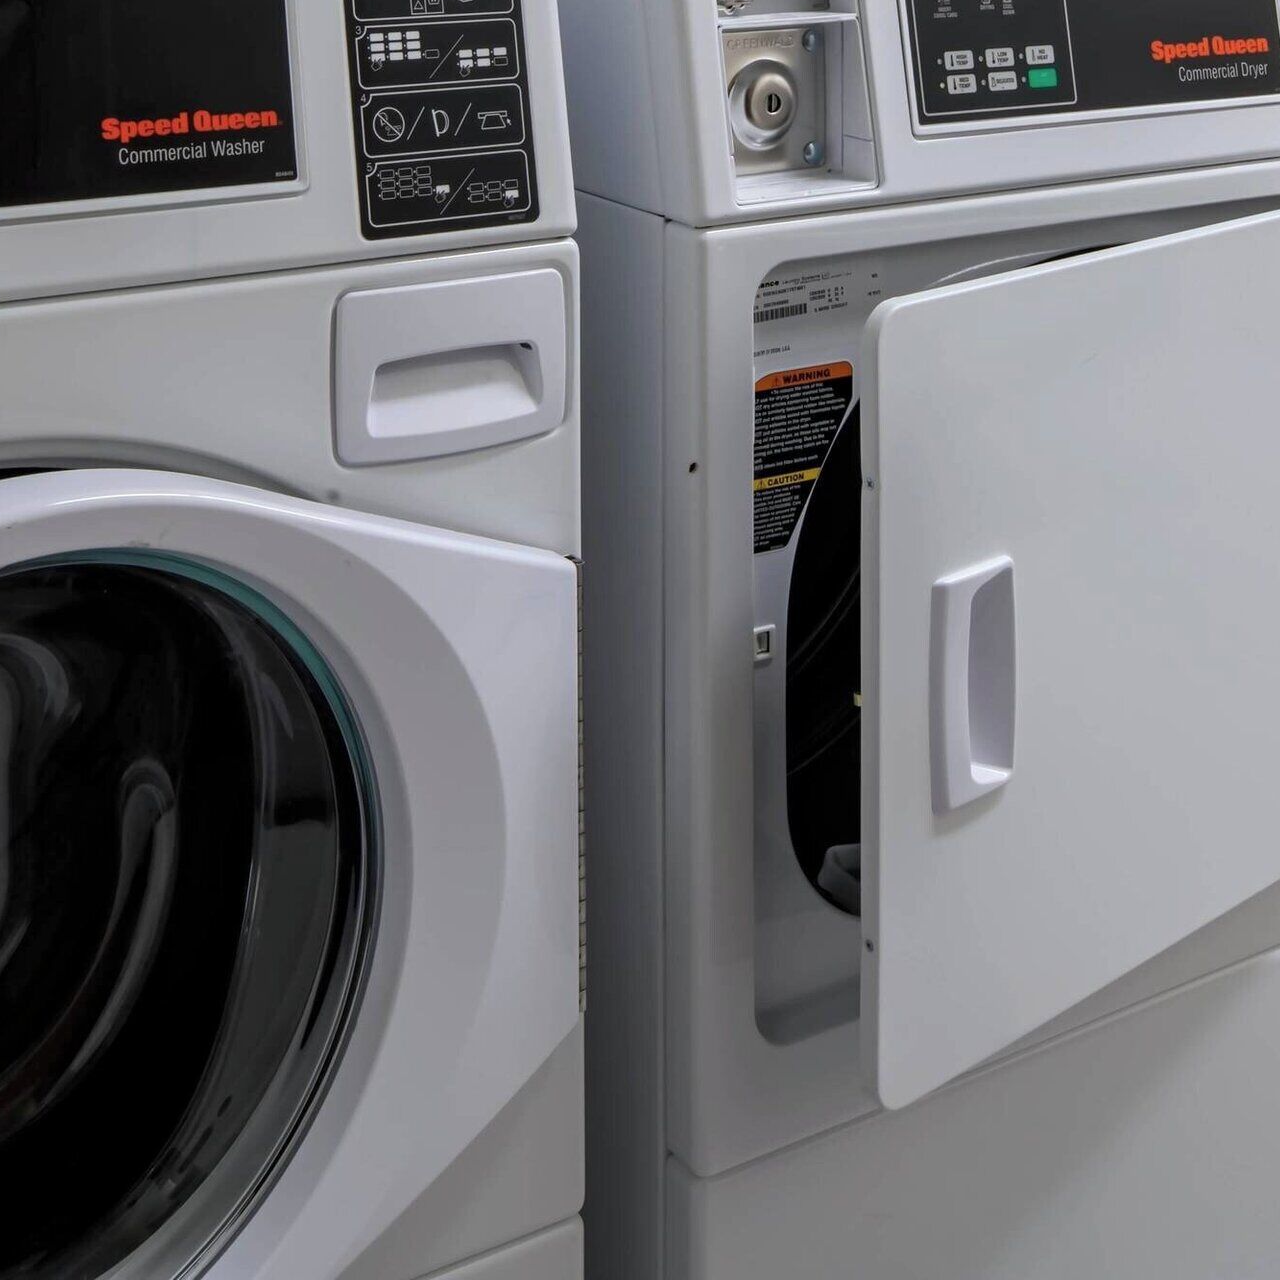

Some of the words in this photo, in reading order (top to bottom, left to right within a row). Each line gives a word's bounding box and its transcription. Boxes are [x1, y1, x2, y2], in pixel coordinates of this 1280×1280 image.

[355, 24, 362, 35] 3
[1150, 37, 1209, 63] Speed
[1212, 35, 1269, 55] Queen
[1179, 63, 1239, 81] Commercial
[1241, 62, 1268, 79] Dryer
[360, 93, 367, 103] 4
[101, 111, 189, 143] Speed
[193, 109, 278, 132] Queen
[119, 141, 206, 166] Commercial
[212, 138, 265, 157] Washer
[366, 162, 373, 172] 5
[759, 280, 779, 288] ance
[783, 369, 831, 384] WARNING
[767, 473, 804, 486] CAUTION
